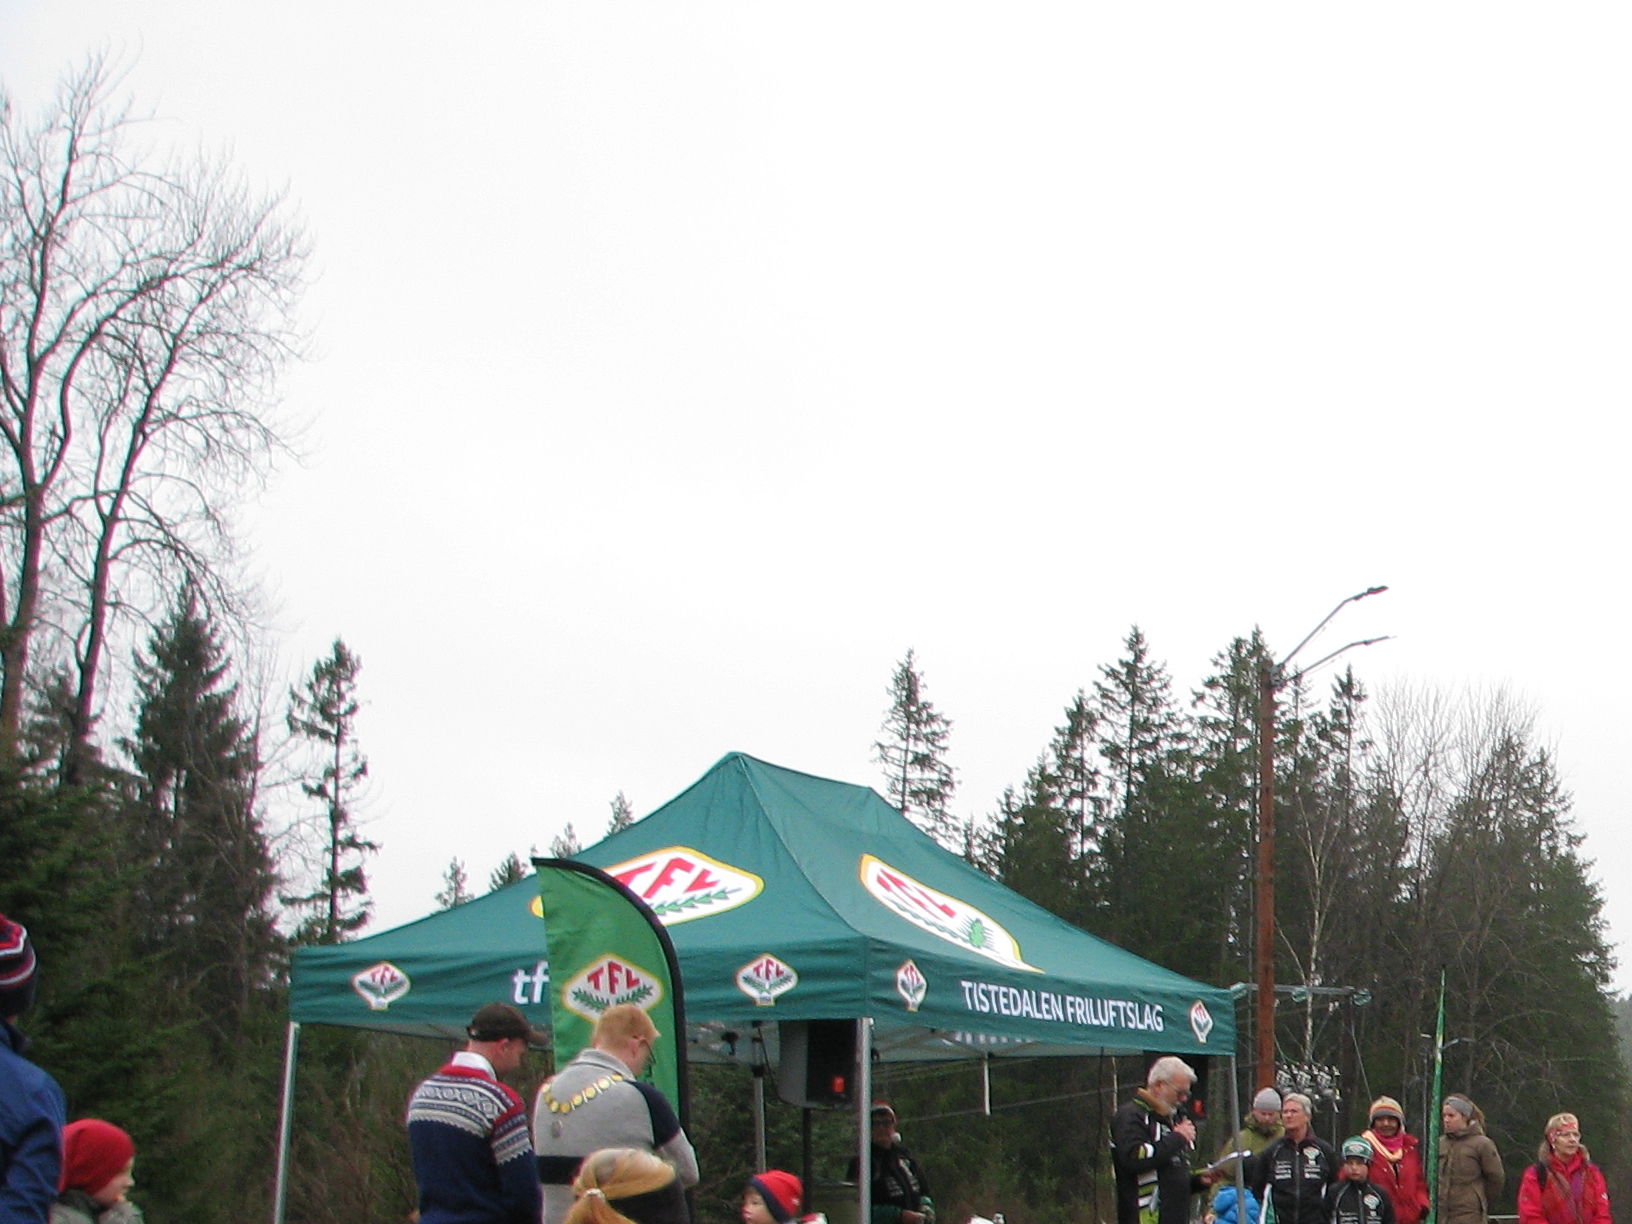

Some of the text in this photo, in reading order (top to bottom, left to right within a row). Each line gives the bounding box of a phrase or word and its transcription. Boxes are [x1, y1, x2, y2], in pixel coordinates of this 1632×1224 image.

[587, 961, 640, 995] TFL
[961, 980, 1165, 1032] TISTEDALEN FRILUFTSLAG
